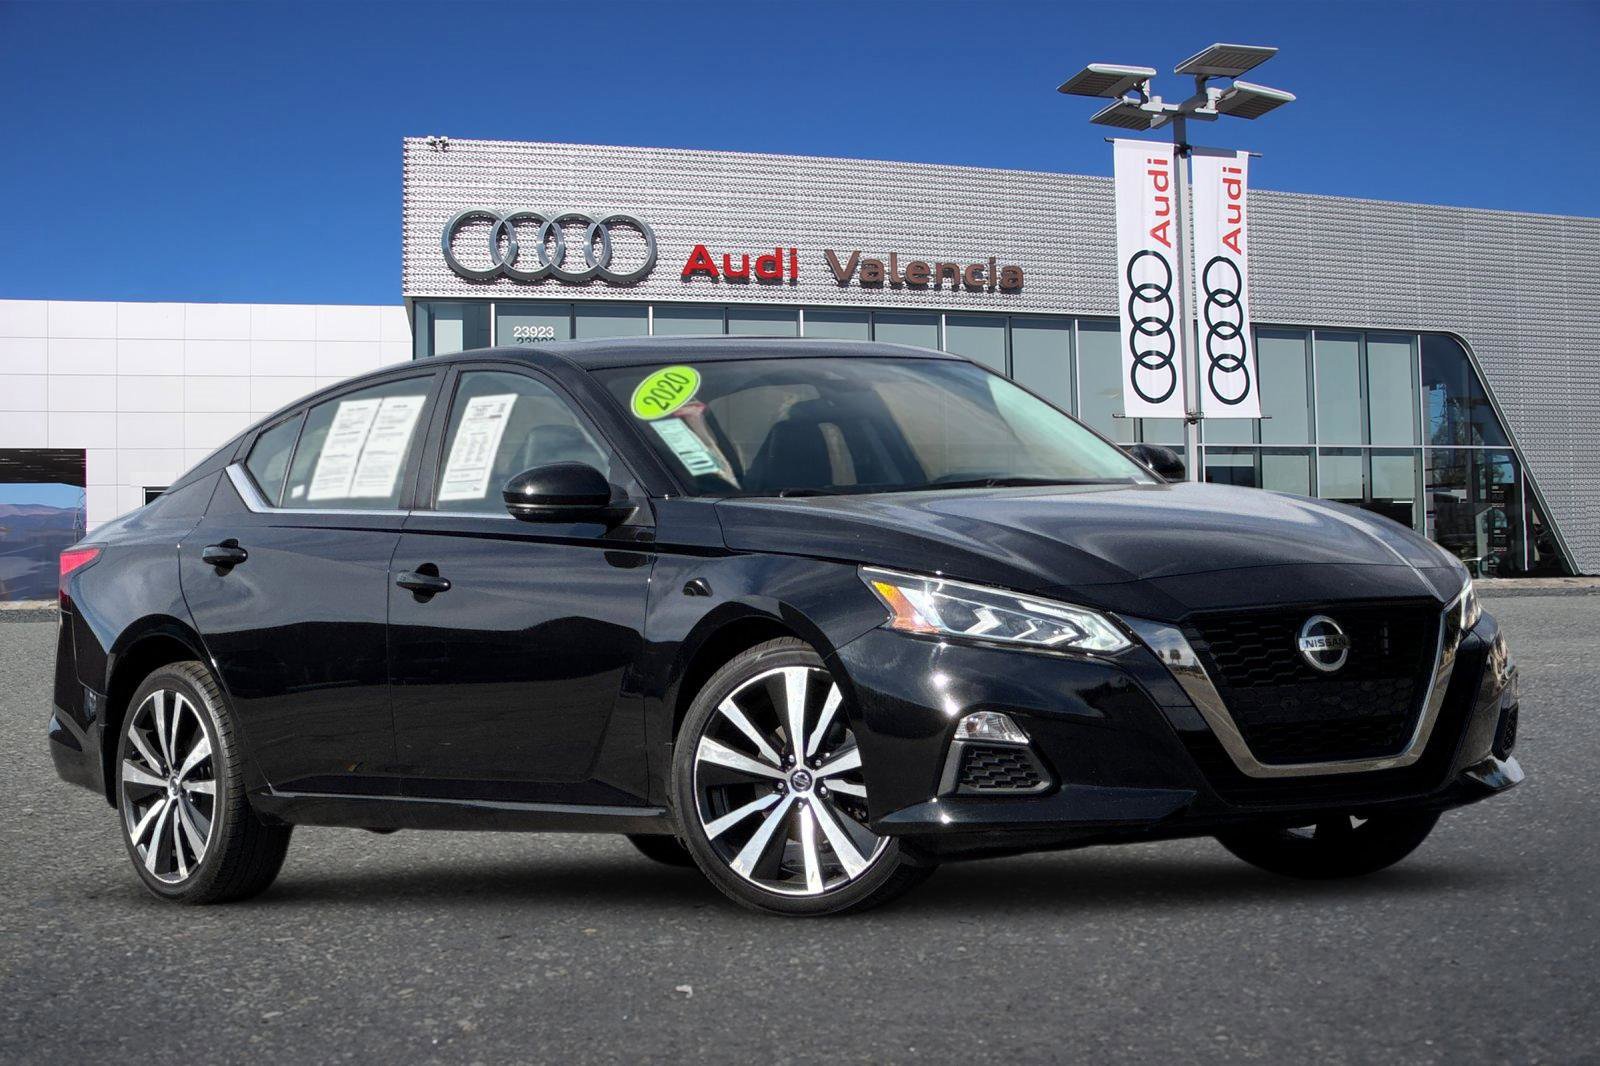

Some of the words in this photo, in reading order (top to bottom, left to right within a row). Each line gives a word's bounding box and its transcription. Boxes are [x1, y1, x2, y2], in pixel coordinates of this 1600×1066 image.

[1147, 158, 1171, 248] Audi
[1222, 166, 1242, 255] Audi
[681, 244, 798, 282] Audi
[825, 249, 1024, 293] Valencia
[513, 326, 555, 338] 23923
[643, 372, 690, 411] 2020
[1305, 637, 1346, 648] NISSAN
